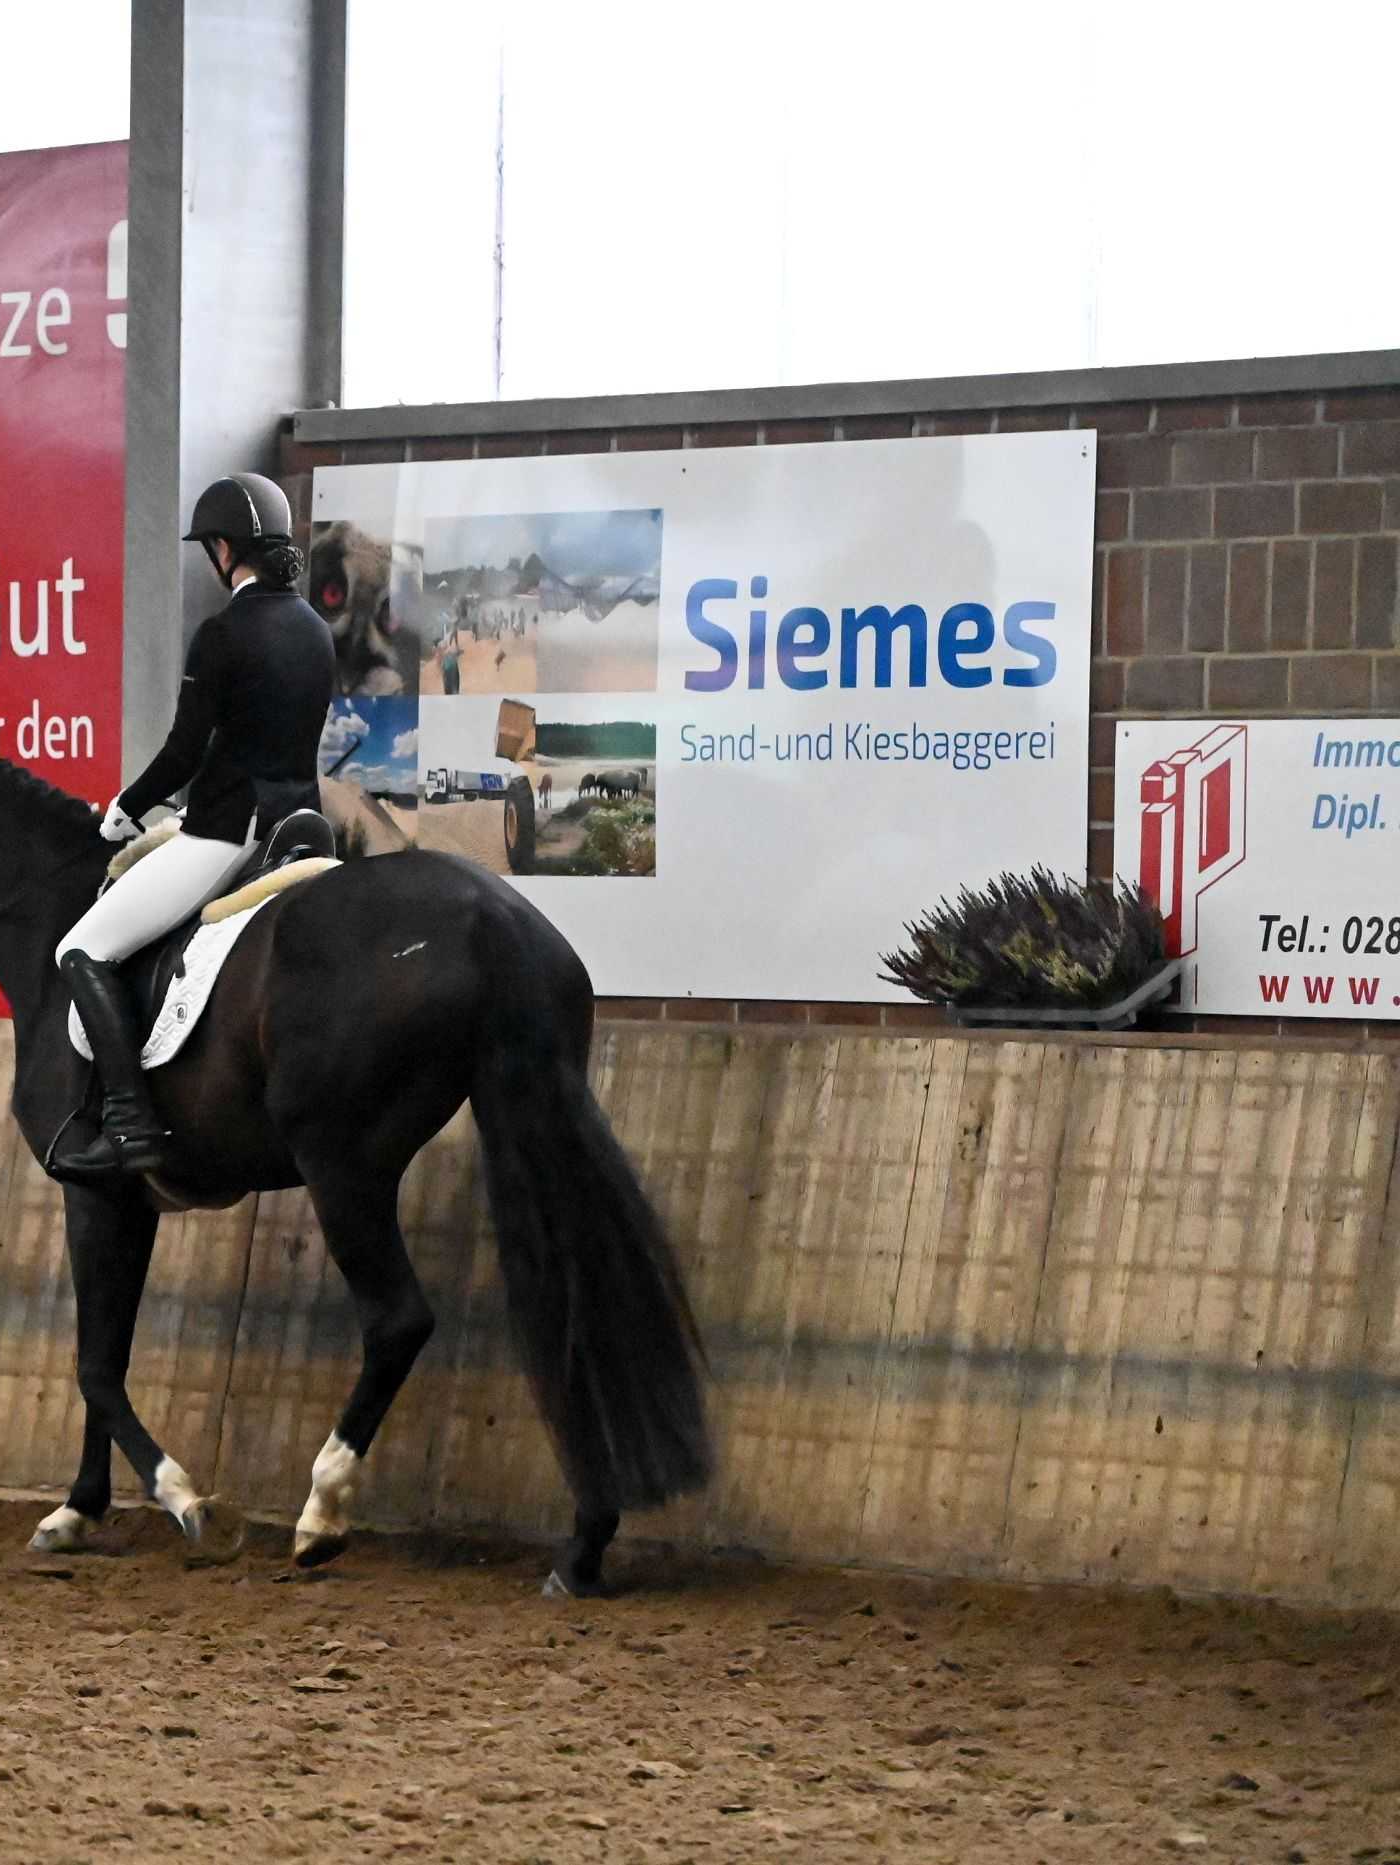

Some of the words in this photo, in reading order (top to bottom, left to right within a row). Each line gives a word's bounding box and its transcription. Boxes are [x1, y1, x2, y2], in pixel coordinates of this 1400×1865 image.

[684, 575, 1058, 693] Siemes
[16, 698, 94, 760] den
[679, 722, 834, 763] Sand-und
[844, 721, 1056, 770] Kiesbaggerei
[1312, 793, 1386, 839] Dipl.
[1258, 914, 1329, 953] Tel.:
